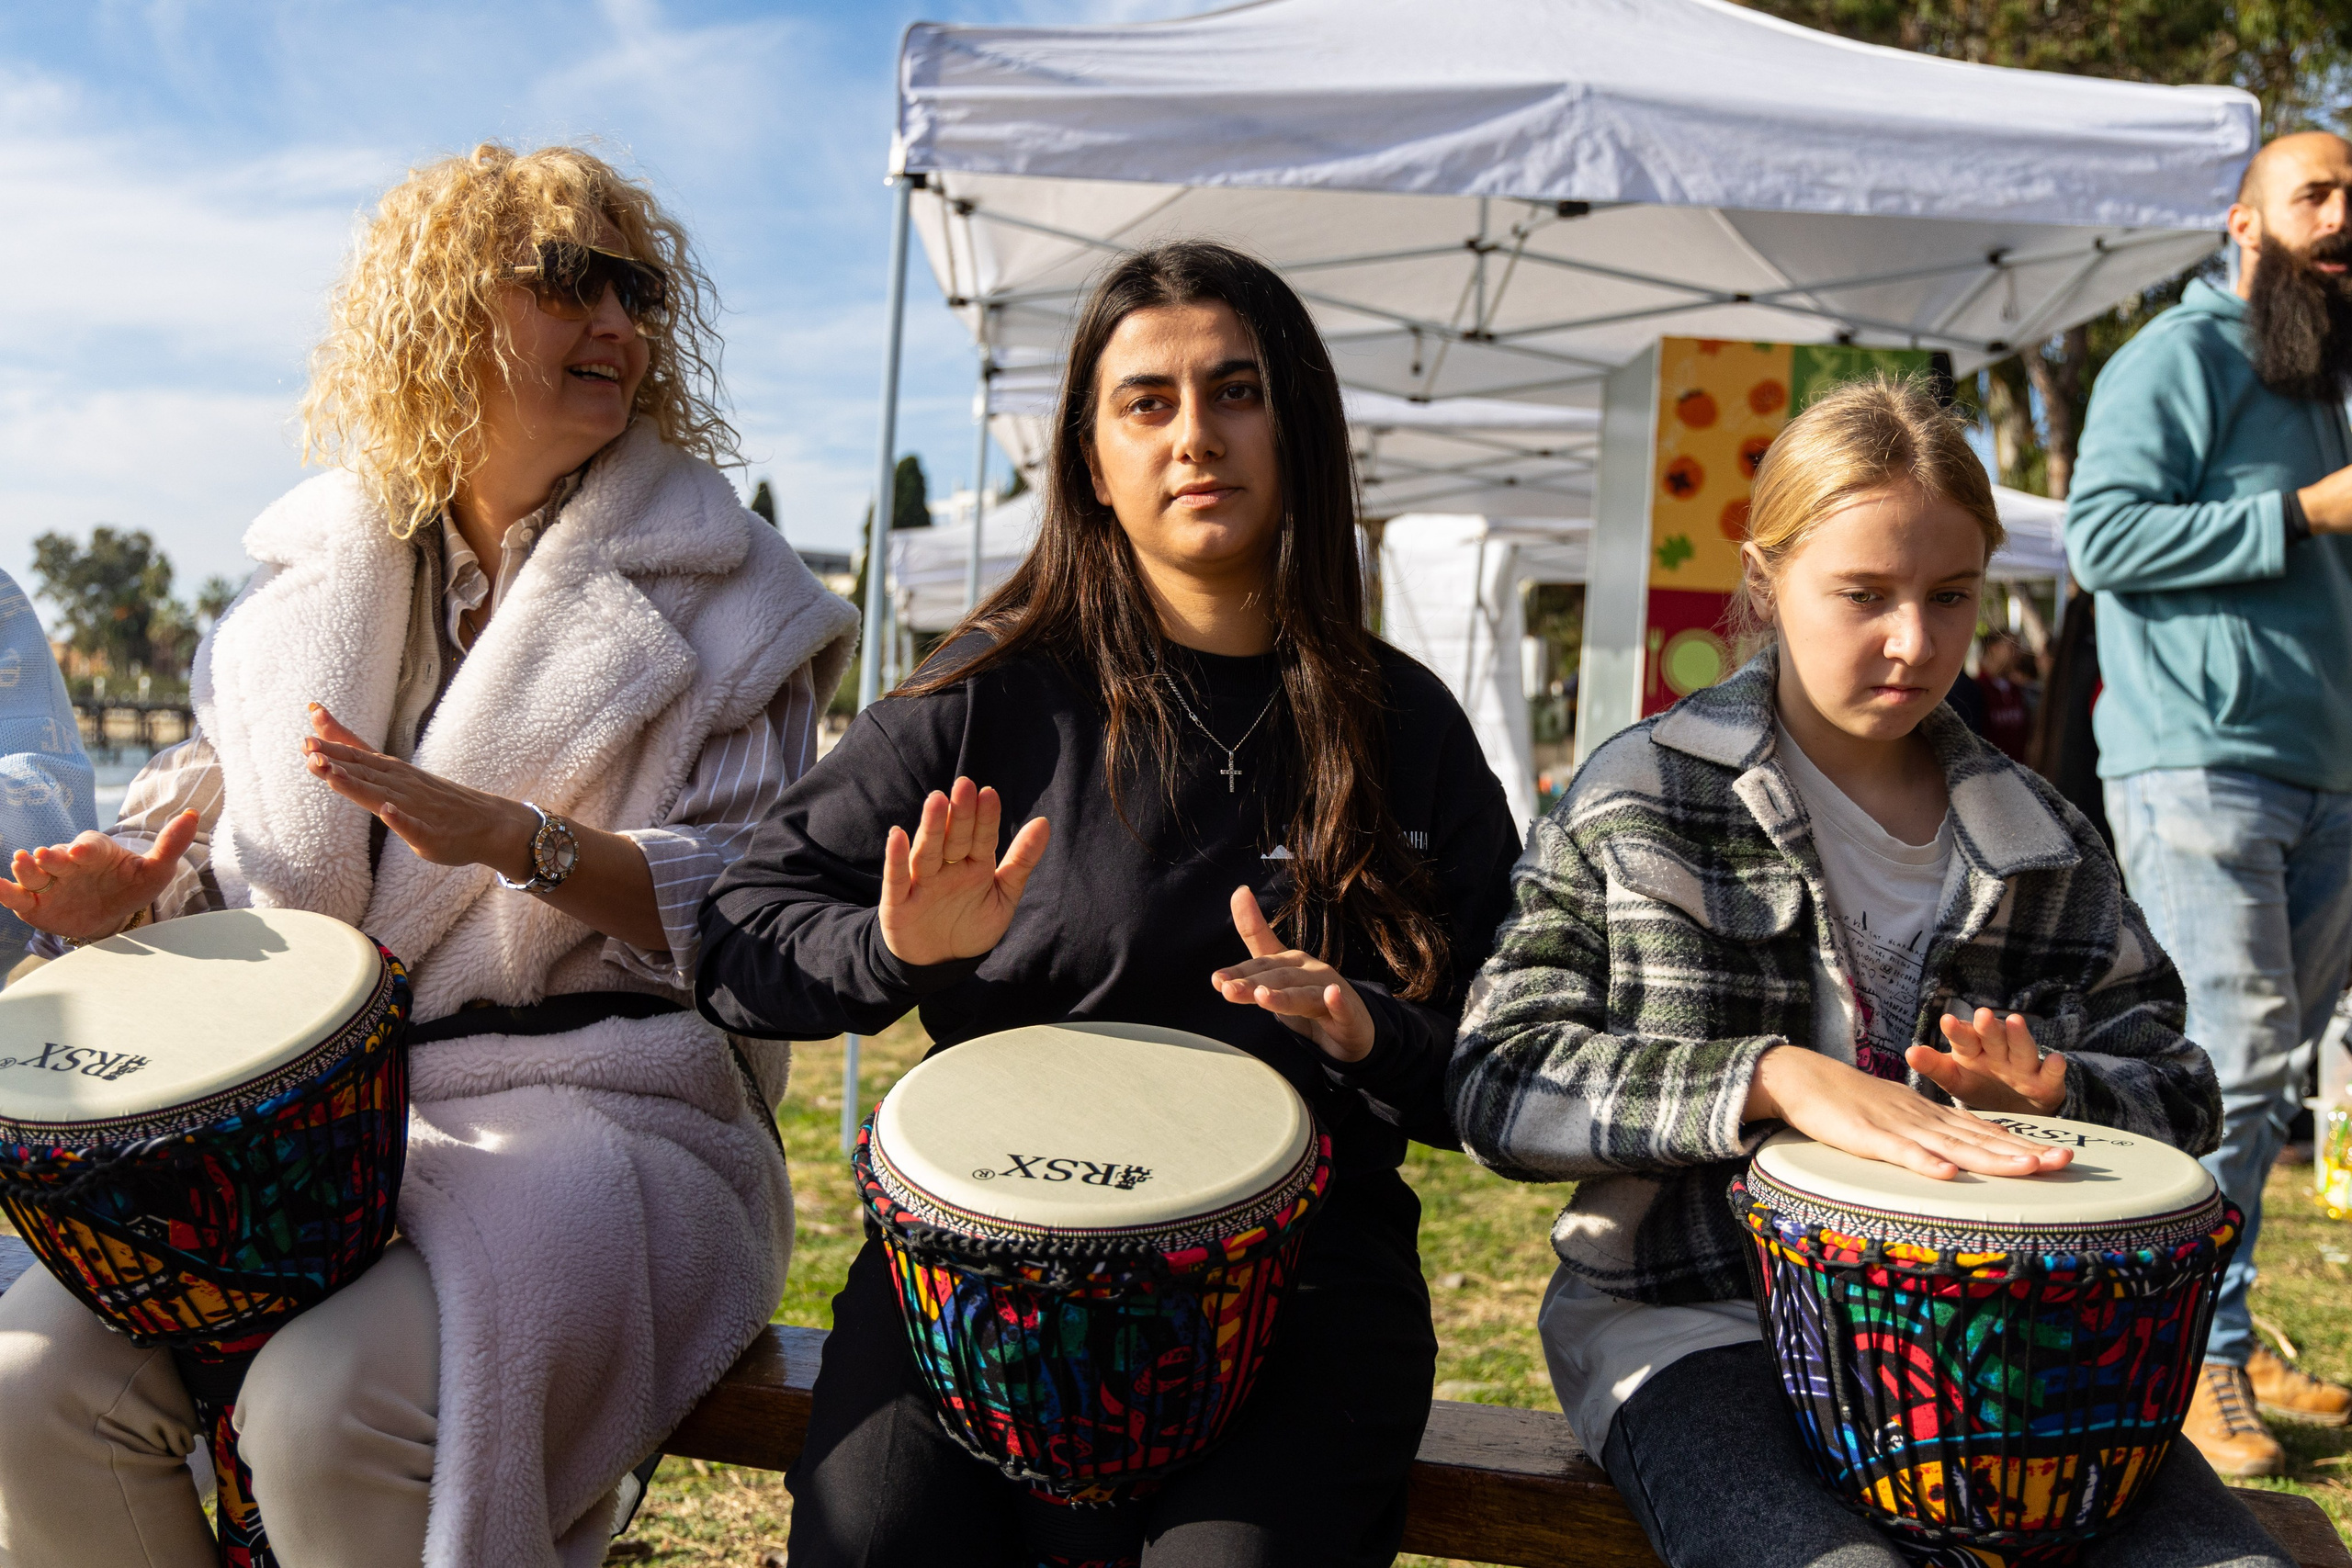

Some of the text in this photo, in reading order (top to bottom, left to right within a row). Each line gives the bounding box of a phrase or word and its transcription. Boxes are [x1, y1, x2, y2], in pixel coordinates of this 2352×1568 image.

[17, 1042, 130, 1077] RSX
[2005, 1120, 2109, 1147] RSX
[998, 1154, 1121, 1187] RSX
